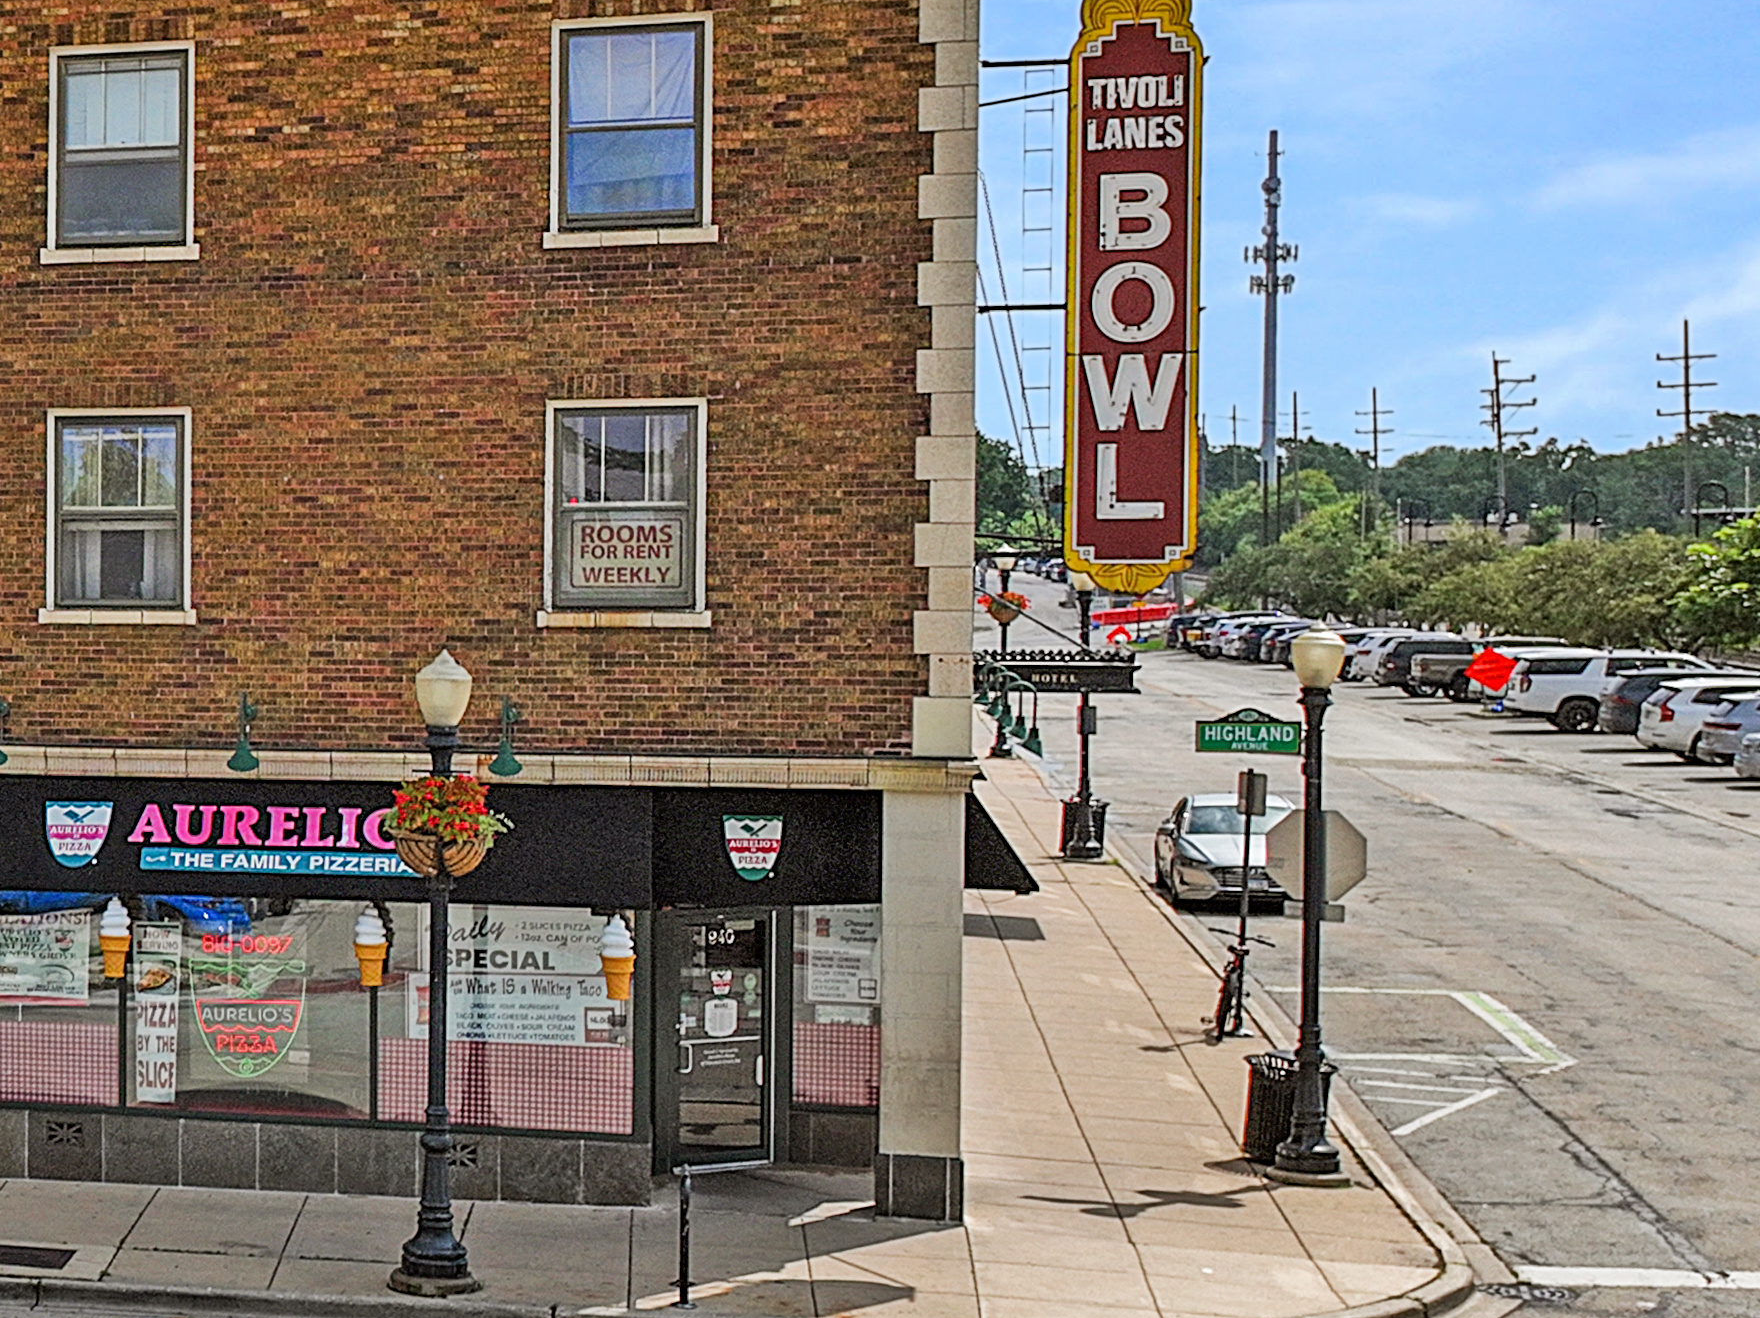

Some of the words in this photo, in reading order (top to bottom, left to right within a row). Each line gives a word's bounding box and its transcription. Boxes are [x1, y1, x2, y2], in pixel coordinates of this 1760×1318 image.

[1087, 75, 1184, 109] TIVOLI
[1086, 115, 1184, 151] LANES
[1082, 172, 1183, 521] BOWL
[580, 525, 673, 544] ROOMS
[580, 545, 618, 560] FOR
[623, 545, 674, 560] RENT
[582, 567, 671, 583] WEEKLY
[1031, 673, 1079, 684] HOTEL
[1204, 726, 1294, 742] HIGHLAND
[1231, 742, 1269, 750] AVENUE
[50, 825, 104, 834] AURELIO'S
[126, 803, 396, 850] AURELIO
[58, 842, 91, 851] PIZZA
[729, 839, 778, 848] AURELIO'S
[170, 852, 215, 870] THE
[220, 853, 302, 872] FAMILY
[309, 855, 413, 874] PIZZERIA
[738, 856, 767, 864] PIZZA
[143, 929, 171, 939] NOW
[521, 921, 527, 930] 2
[529, 922, 561, 931] SLICES
[563, 923, 591, 932] PIZZA
[21, 942, 52, 951] PIZZA
[201, 933, 294, 954] 810-0097
[545, 934, 568, 943] CAN
[570, 935, 582, 943] OF
[586, 936, 601, 944] PO
[465, 977, 497, 995] What
[502, 978, 516, 995] IS
[520, 985, 527, 994] a
[531, 979, 572, 1000] Walking
[577, 979, 603, 997] Taco
[137, 1002, 176, 1028] PIZZA
[202, 1006, 293, 1023] AURELIO'S
[137, 1035, 151, 1053] BY
[156, 1035, 175, 1053] THE
[215, 1035, 278, 1054] PIZZA
[533, 1033, 576, 1041] TOMATOES
[137, 1060, 175, 1089] SLICE
